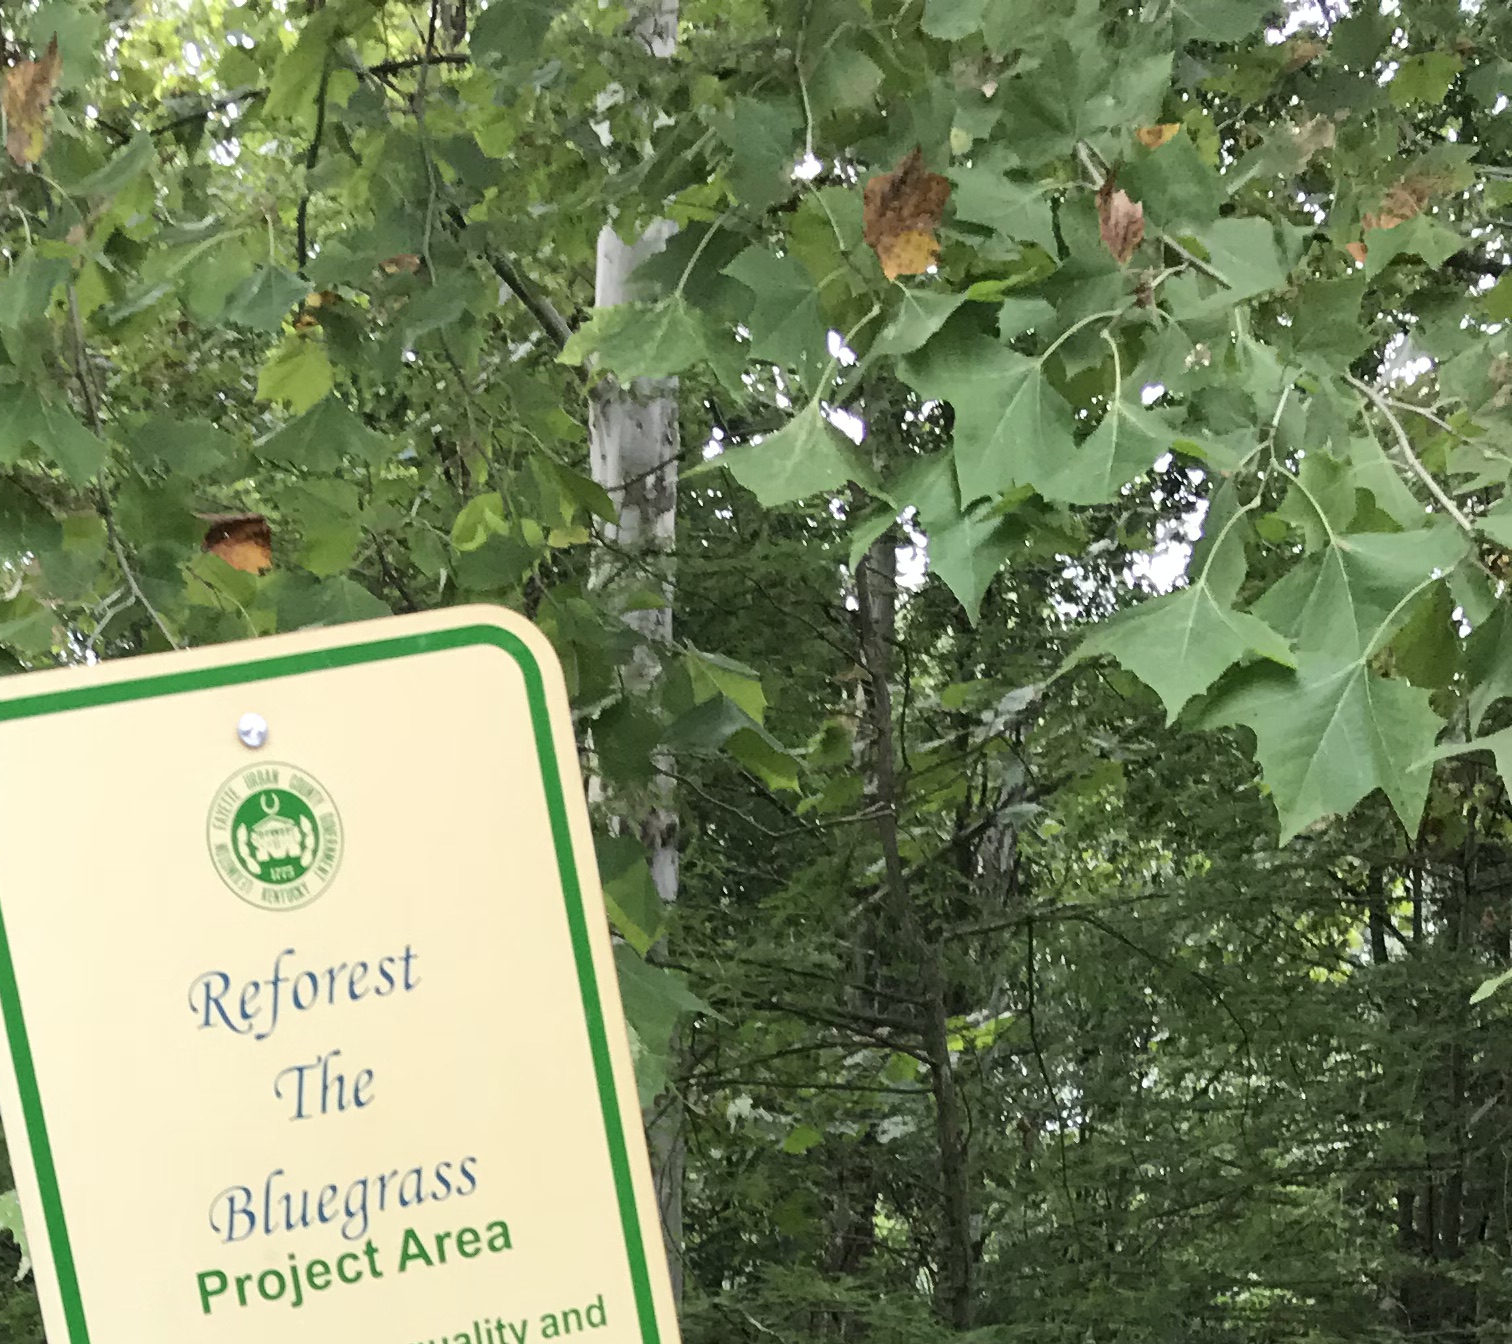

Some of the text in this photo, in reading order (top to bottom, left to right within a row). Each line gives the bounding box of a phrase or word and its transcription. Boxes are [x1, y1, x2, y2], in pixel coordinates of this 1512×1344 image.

[188, 944, 422, 1041] Reforest
[273, 1049, 375, 1122] The
[208, 1156, 478, 1244] Bluegrass
[195, 1219, 514, 1314] Project Area
[540, 1293, 607, 1340] and
